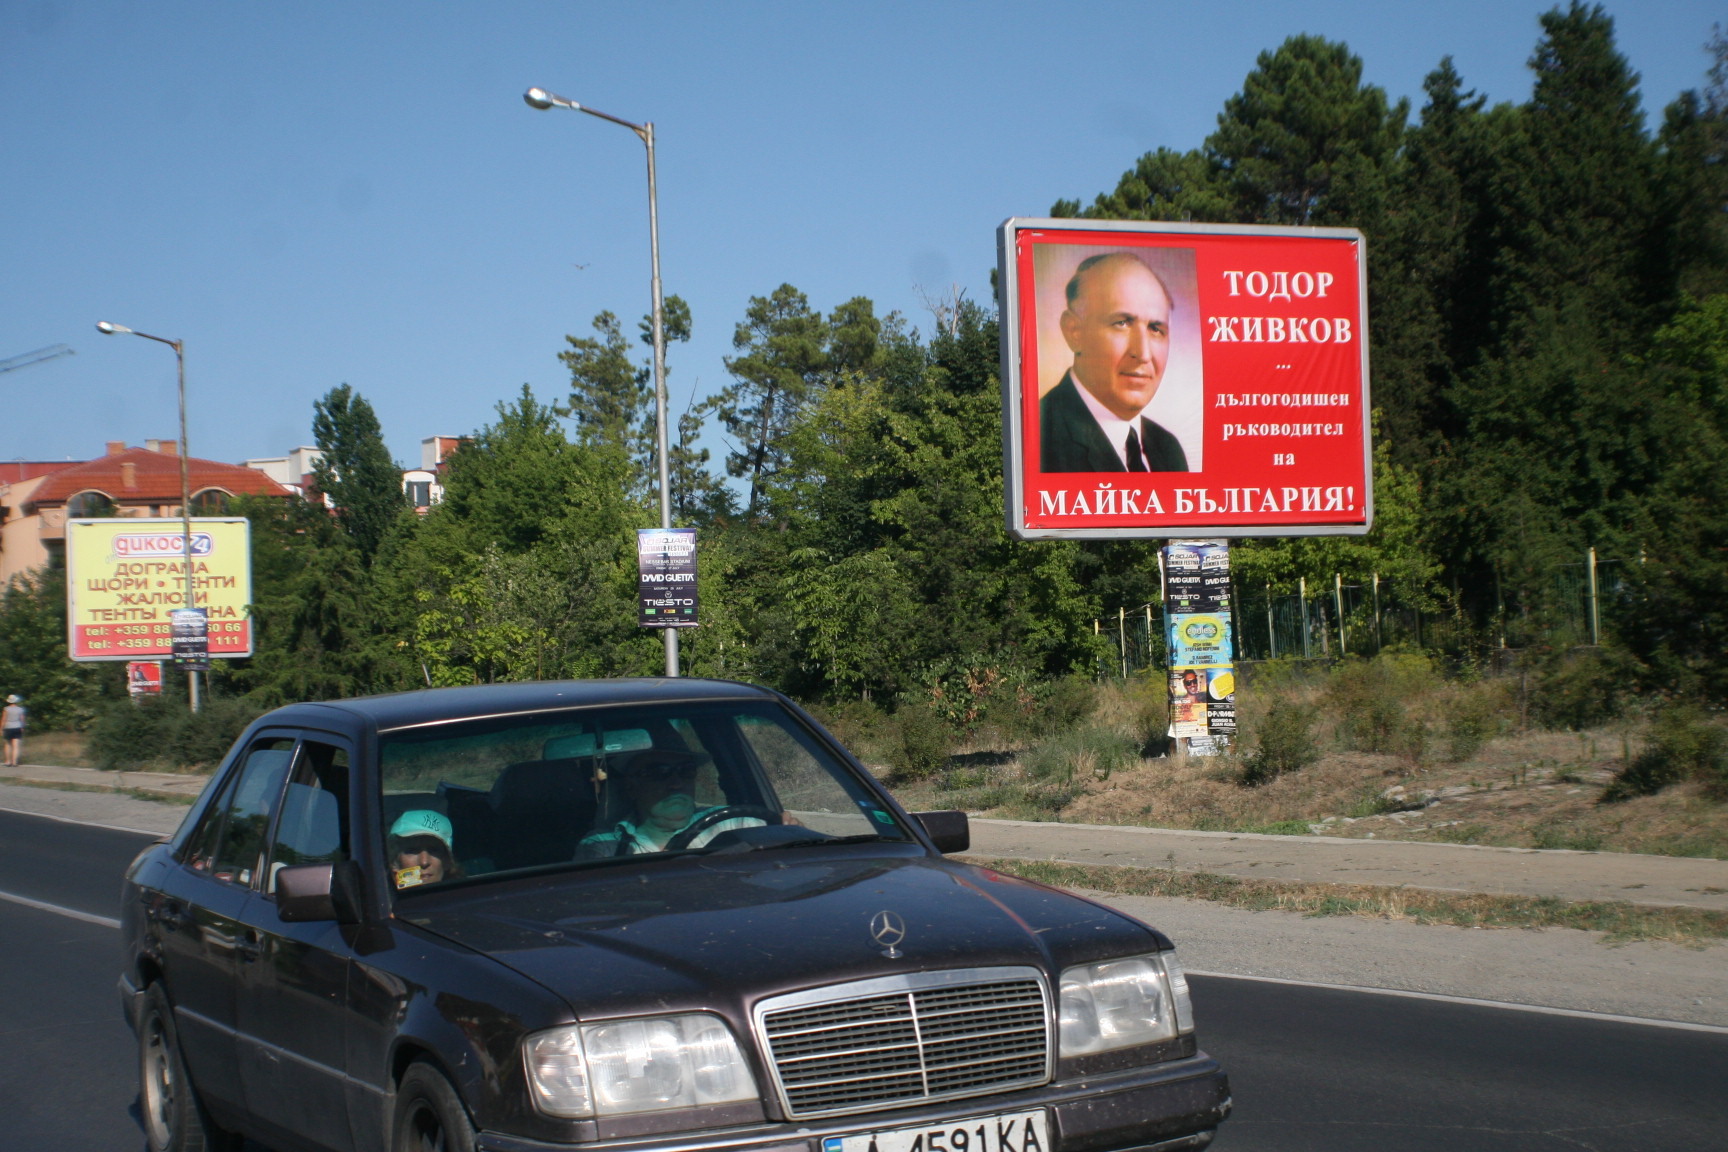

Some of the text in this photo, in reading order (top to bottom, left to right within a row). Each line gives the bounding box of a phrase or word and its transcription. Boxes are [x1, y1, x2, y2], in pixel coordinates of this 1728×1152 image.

[1223, 271, 1334, 302] ТОДОР
[1208, 316, 1352, 344] ЖИВКОВ
[1215, 393, 1350, 408] дългогодишен
[1223, 423, 1344, 440] ръководител
[1273, 452, 1295, 466] на
[1038, 483, 1355, 516] МАЙКА БЪЛГАРИЯ!
[113, 561, 209, 577] ДОГРАМА
[641, 573, 695, 582] DAVID GUETTA
[87, 578, 148, 592] ЩОРИ
[88, 607, 156, 621] ТЕНТЫ
[85, 626, 109, 636] tel:
[114, 625, 148, 635] +359
[224, 622, 241, 632] 66
[88, 640, 112, 649] tel:
[117, 638, 151, 648] +359
[215, 636, 239, 645] 111
